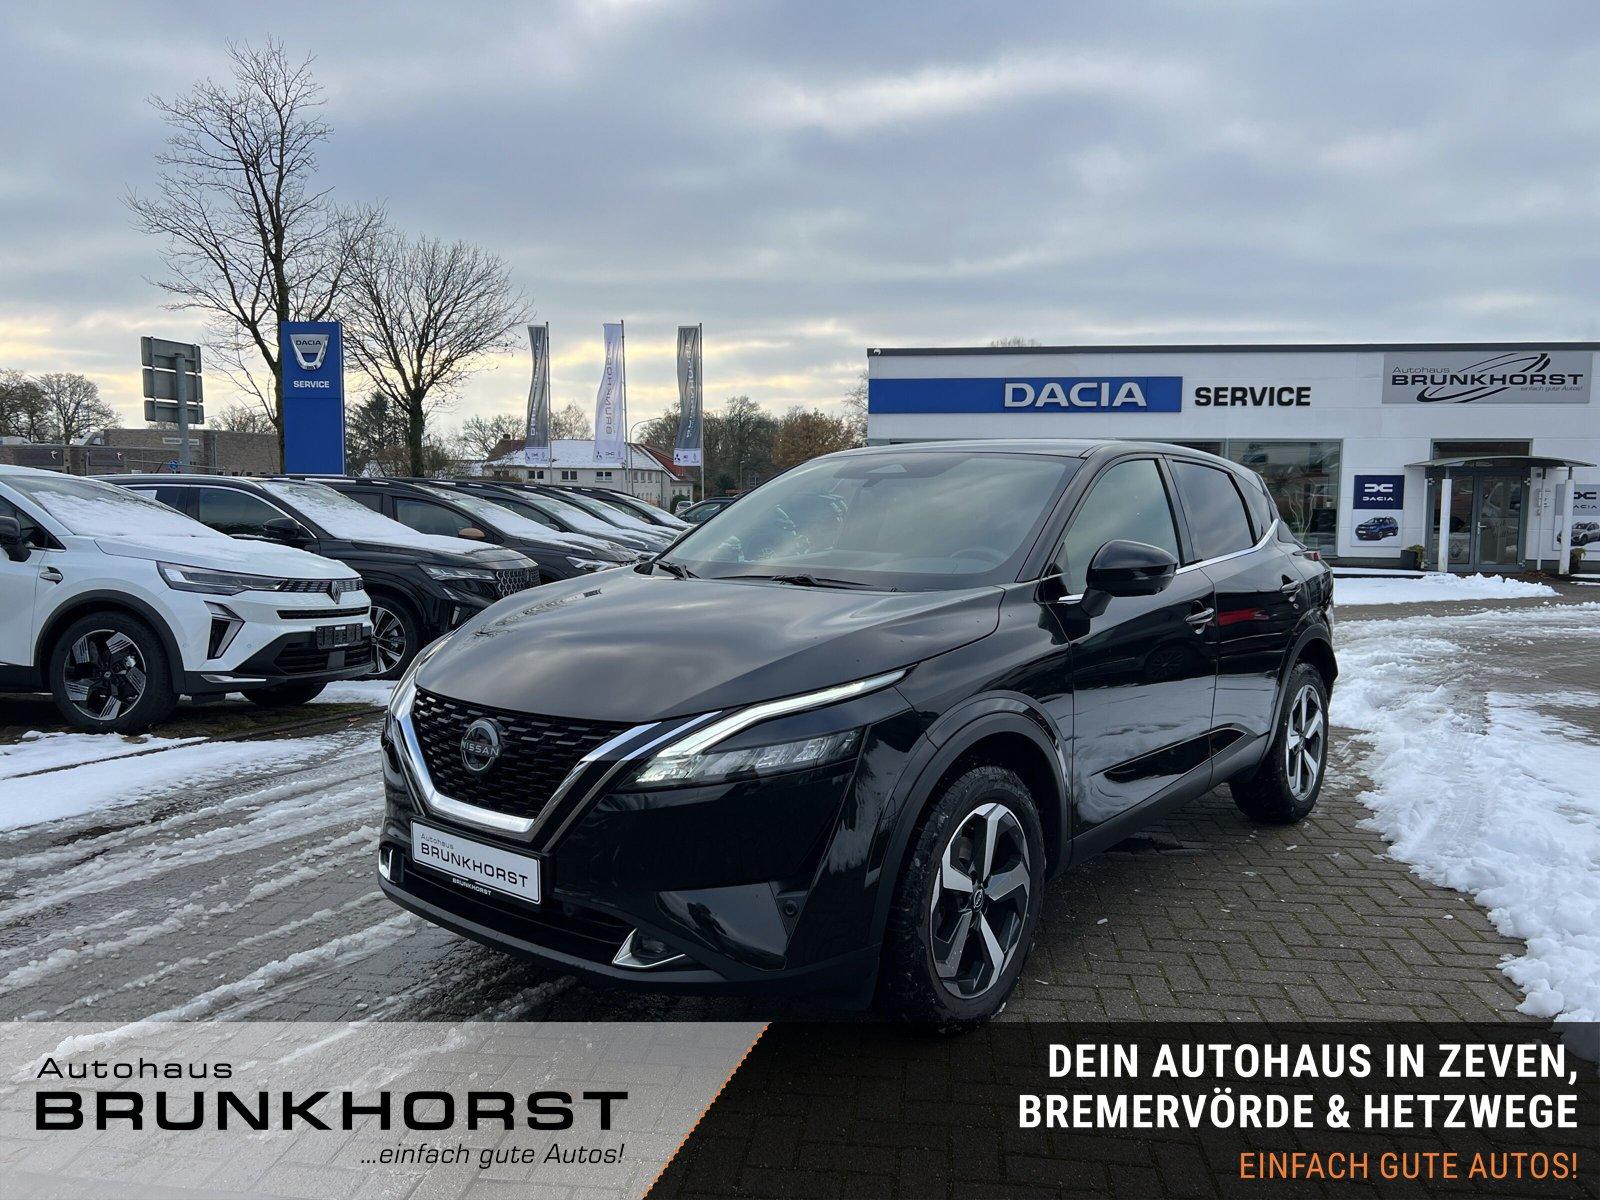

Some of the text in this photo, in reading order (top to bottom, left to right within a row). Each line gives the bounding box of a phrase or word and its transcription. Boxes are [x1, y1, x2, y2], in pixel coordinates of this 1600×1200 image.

[1392, 366, 1450, 374] Autohaus
[293, 380, 330, 388] SERVICE
[1391, 374, 1583, 386] BRUNKHORST
[1004, 382, 1147, 407] DACIA
[1194, 386, 1311, 407] SERVICE
[461, 738, 500, 756] NISSAN
[420, 833, 454, 850] Autohaus
[421, 843, 528, 887] BRUNKHORST
[452, 877, 492, 896] BRUNKHORST
